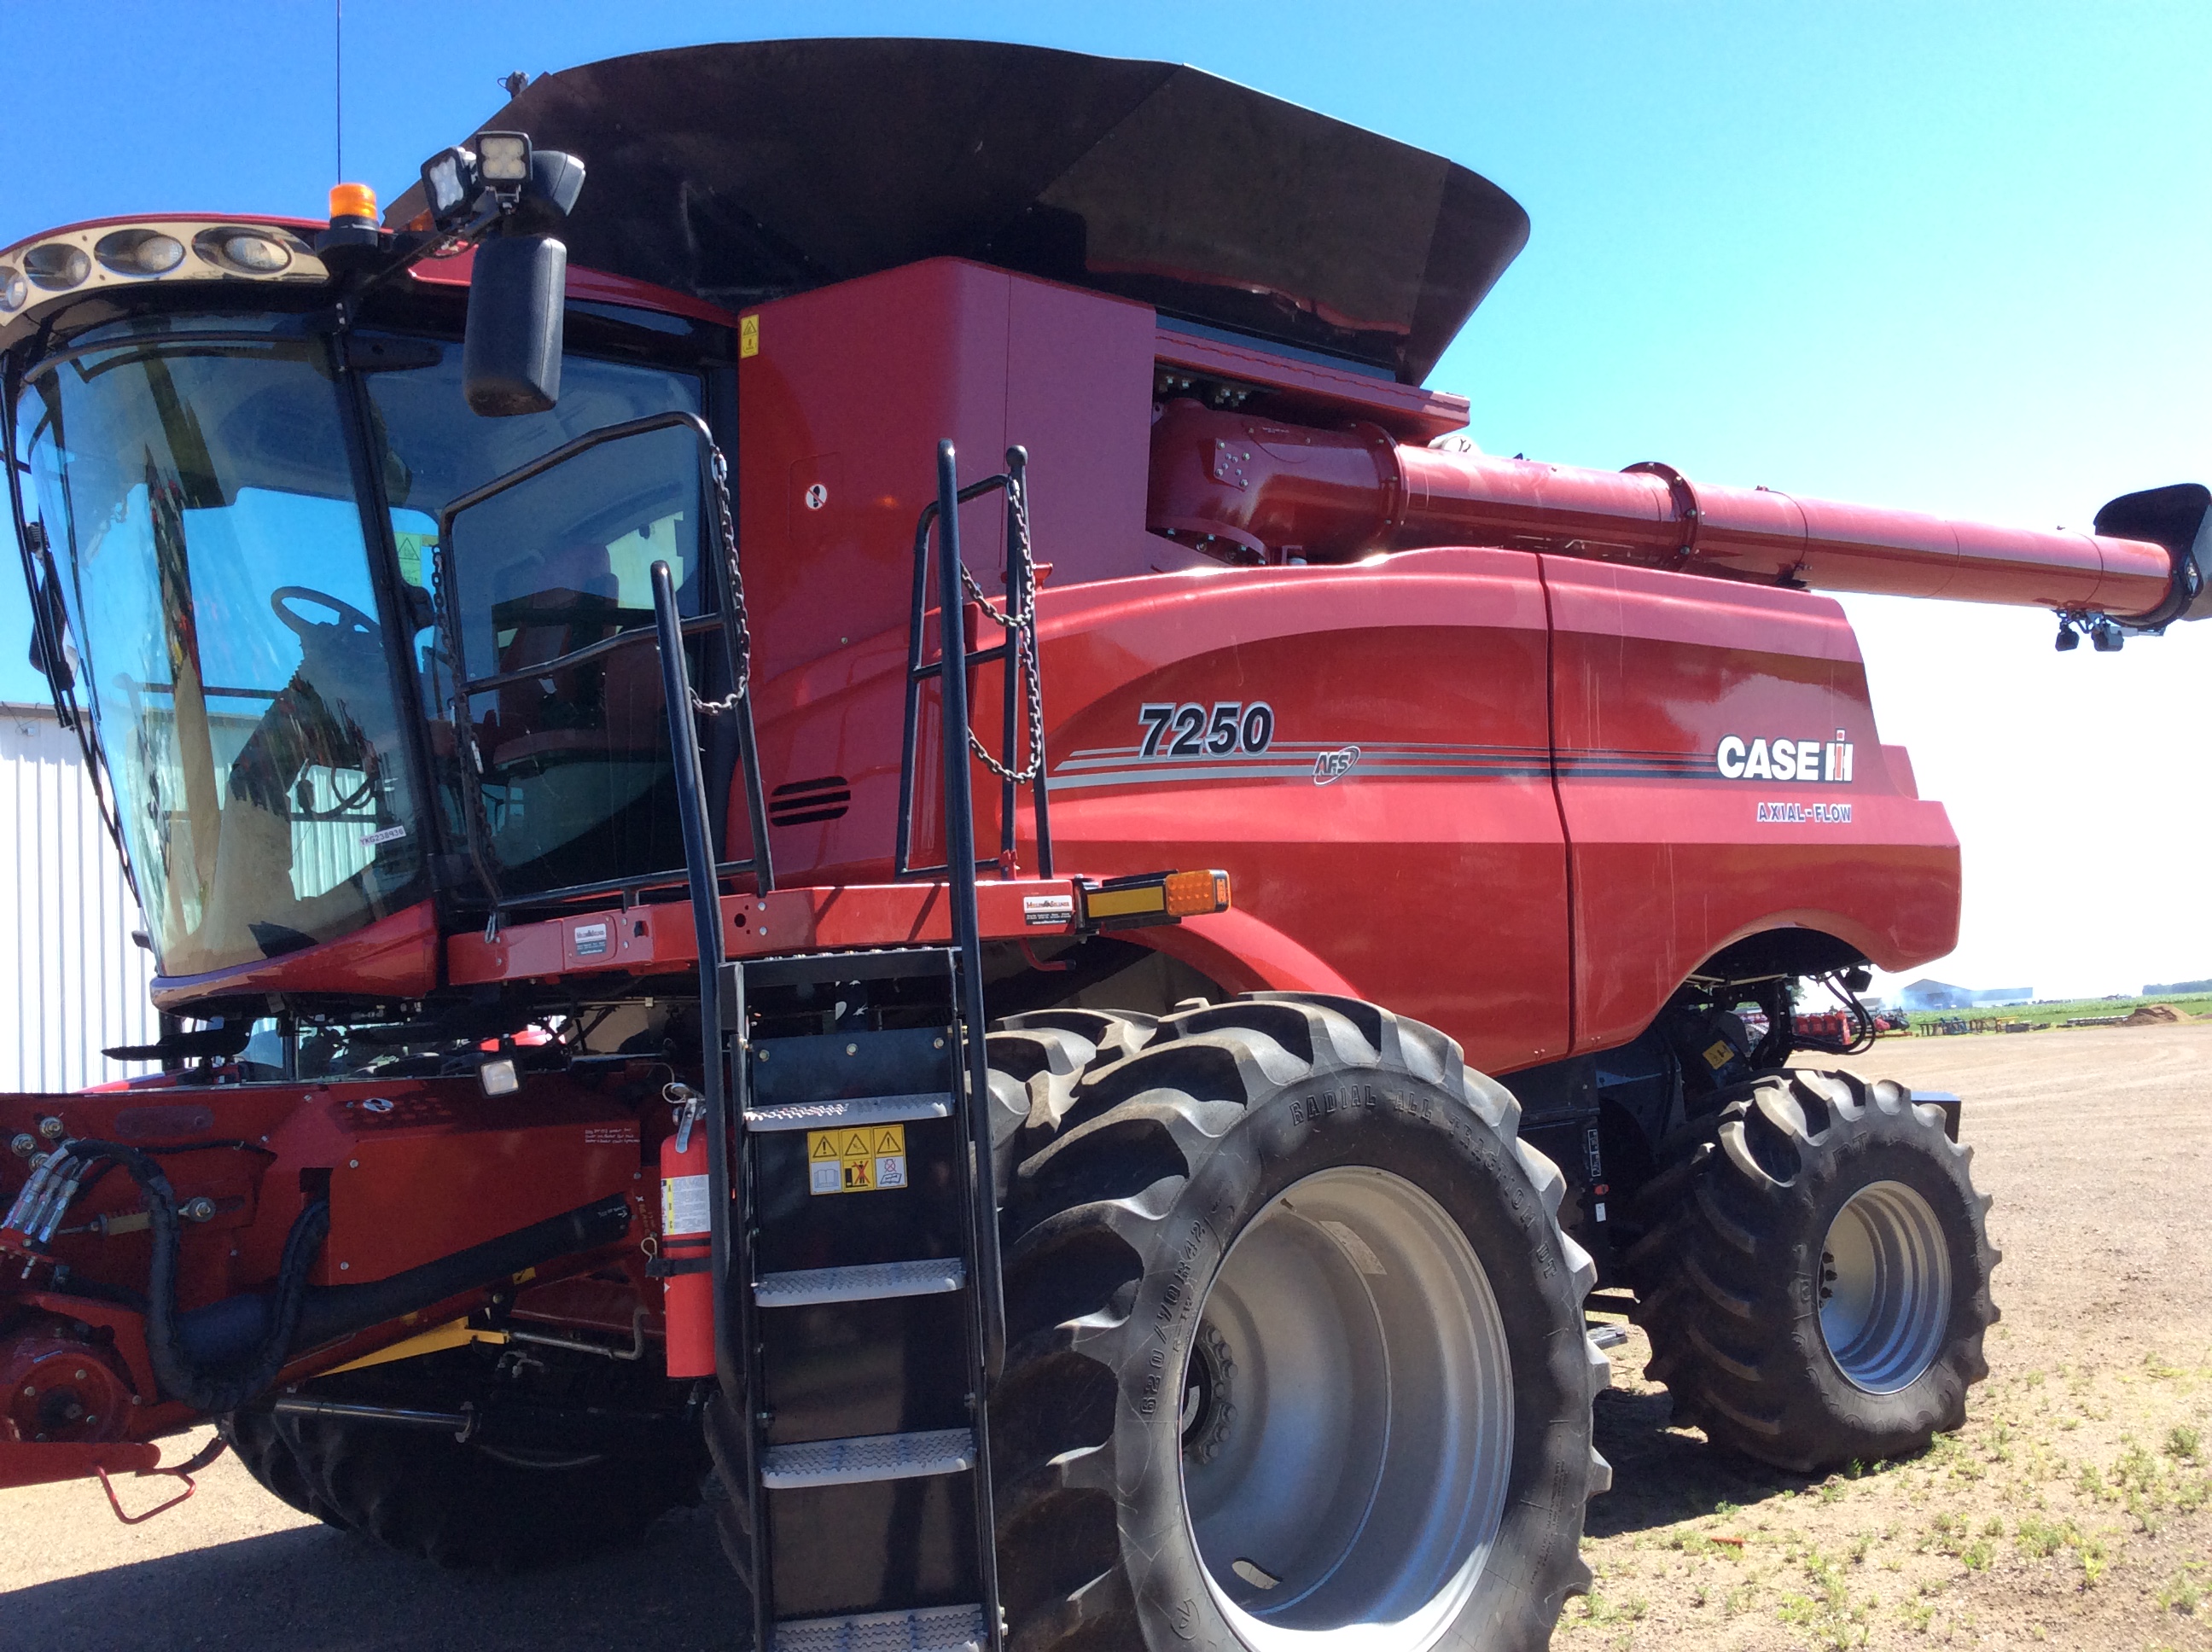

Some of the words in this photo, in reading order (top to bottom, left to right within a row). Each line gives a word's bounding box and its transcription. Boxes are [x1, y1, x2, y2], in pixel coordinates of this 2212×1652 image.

[1138, 701, 1275, 760] 7250
[1313, 751, 1352, 777] AFS
[1717, 735, 1819, 781] CASE
[1756, 802, 1852, 823] AXIAL-FLOW
[359, 828, 404, 845] YKG238936
[1289, 1084, 1377, 1126] RADIAL
[1394, 1089, 1432, 1122] ALL
[1448, 1113, 1536, 1230] TRACTION
